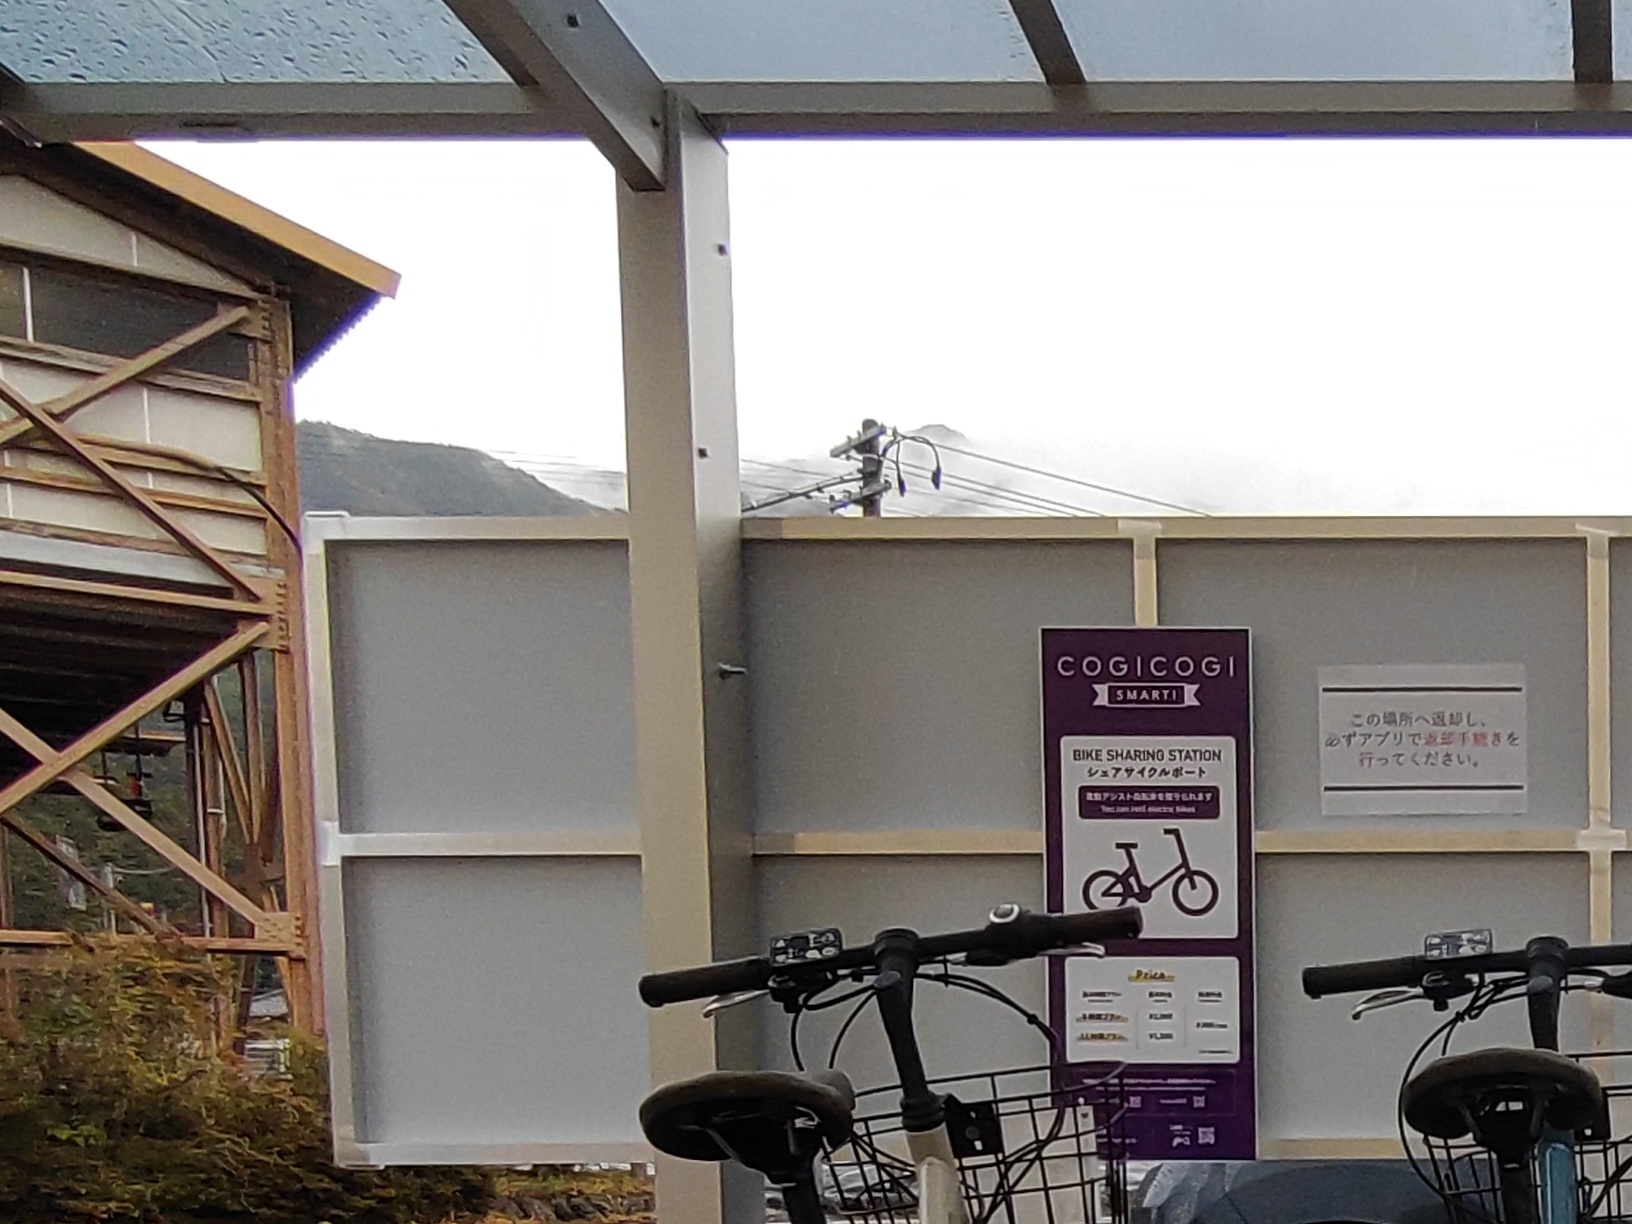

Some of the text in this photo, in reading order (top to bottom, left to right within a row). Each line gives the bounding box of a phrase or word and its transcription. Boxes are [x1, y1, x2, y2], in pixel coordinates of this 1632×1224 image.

[1057, 656, 1235, 677] COGICOGI
[1072, 749, 1222, 762] BIKE SHARING STATION
[1359, 752, 1480, 768] 行ってください。
[1087, 766, 1207, 779] シェアサイクルポート
